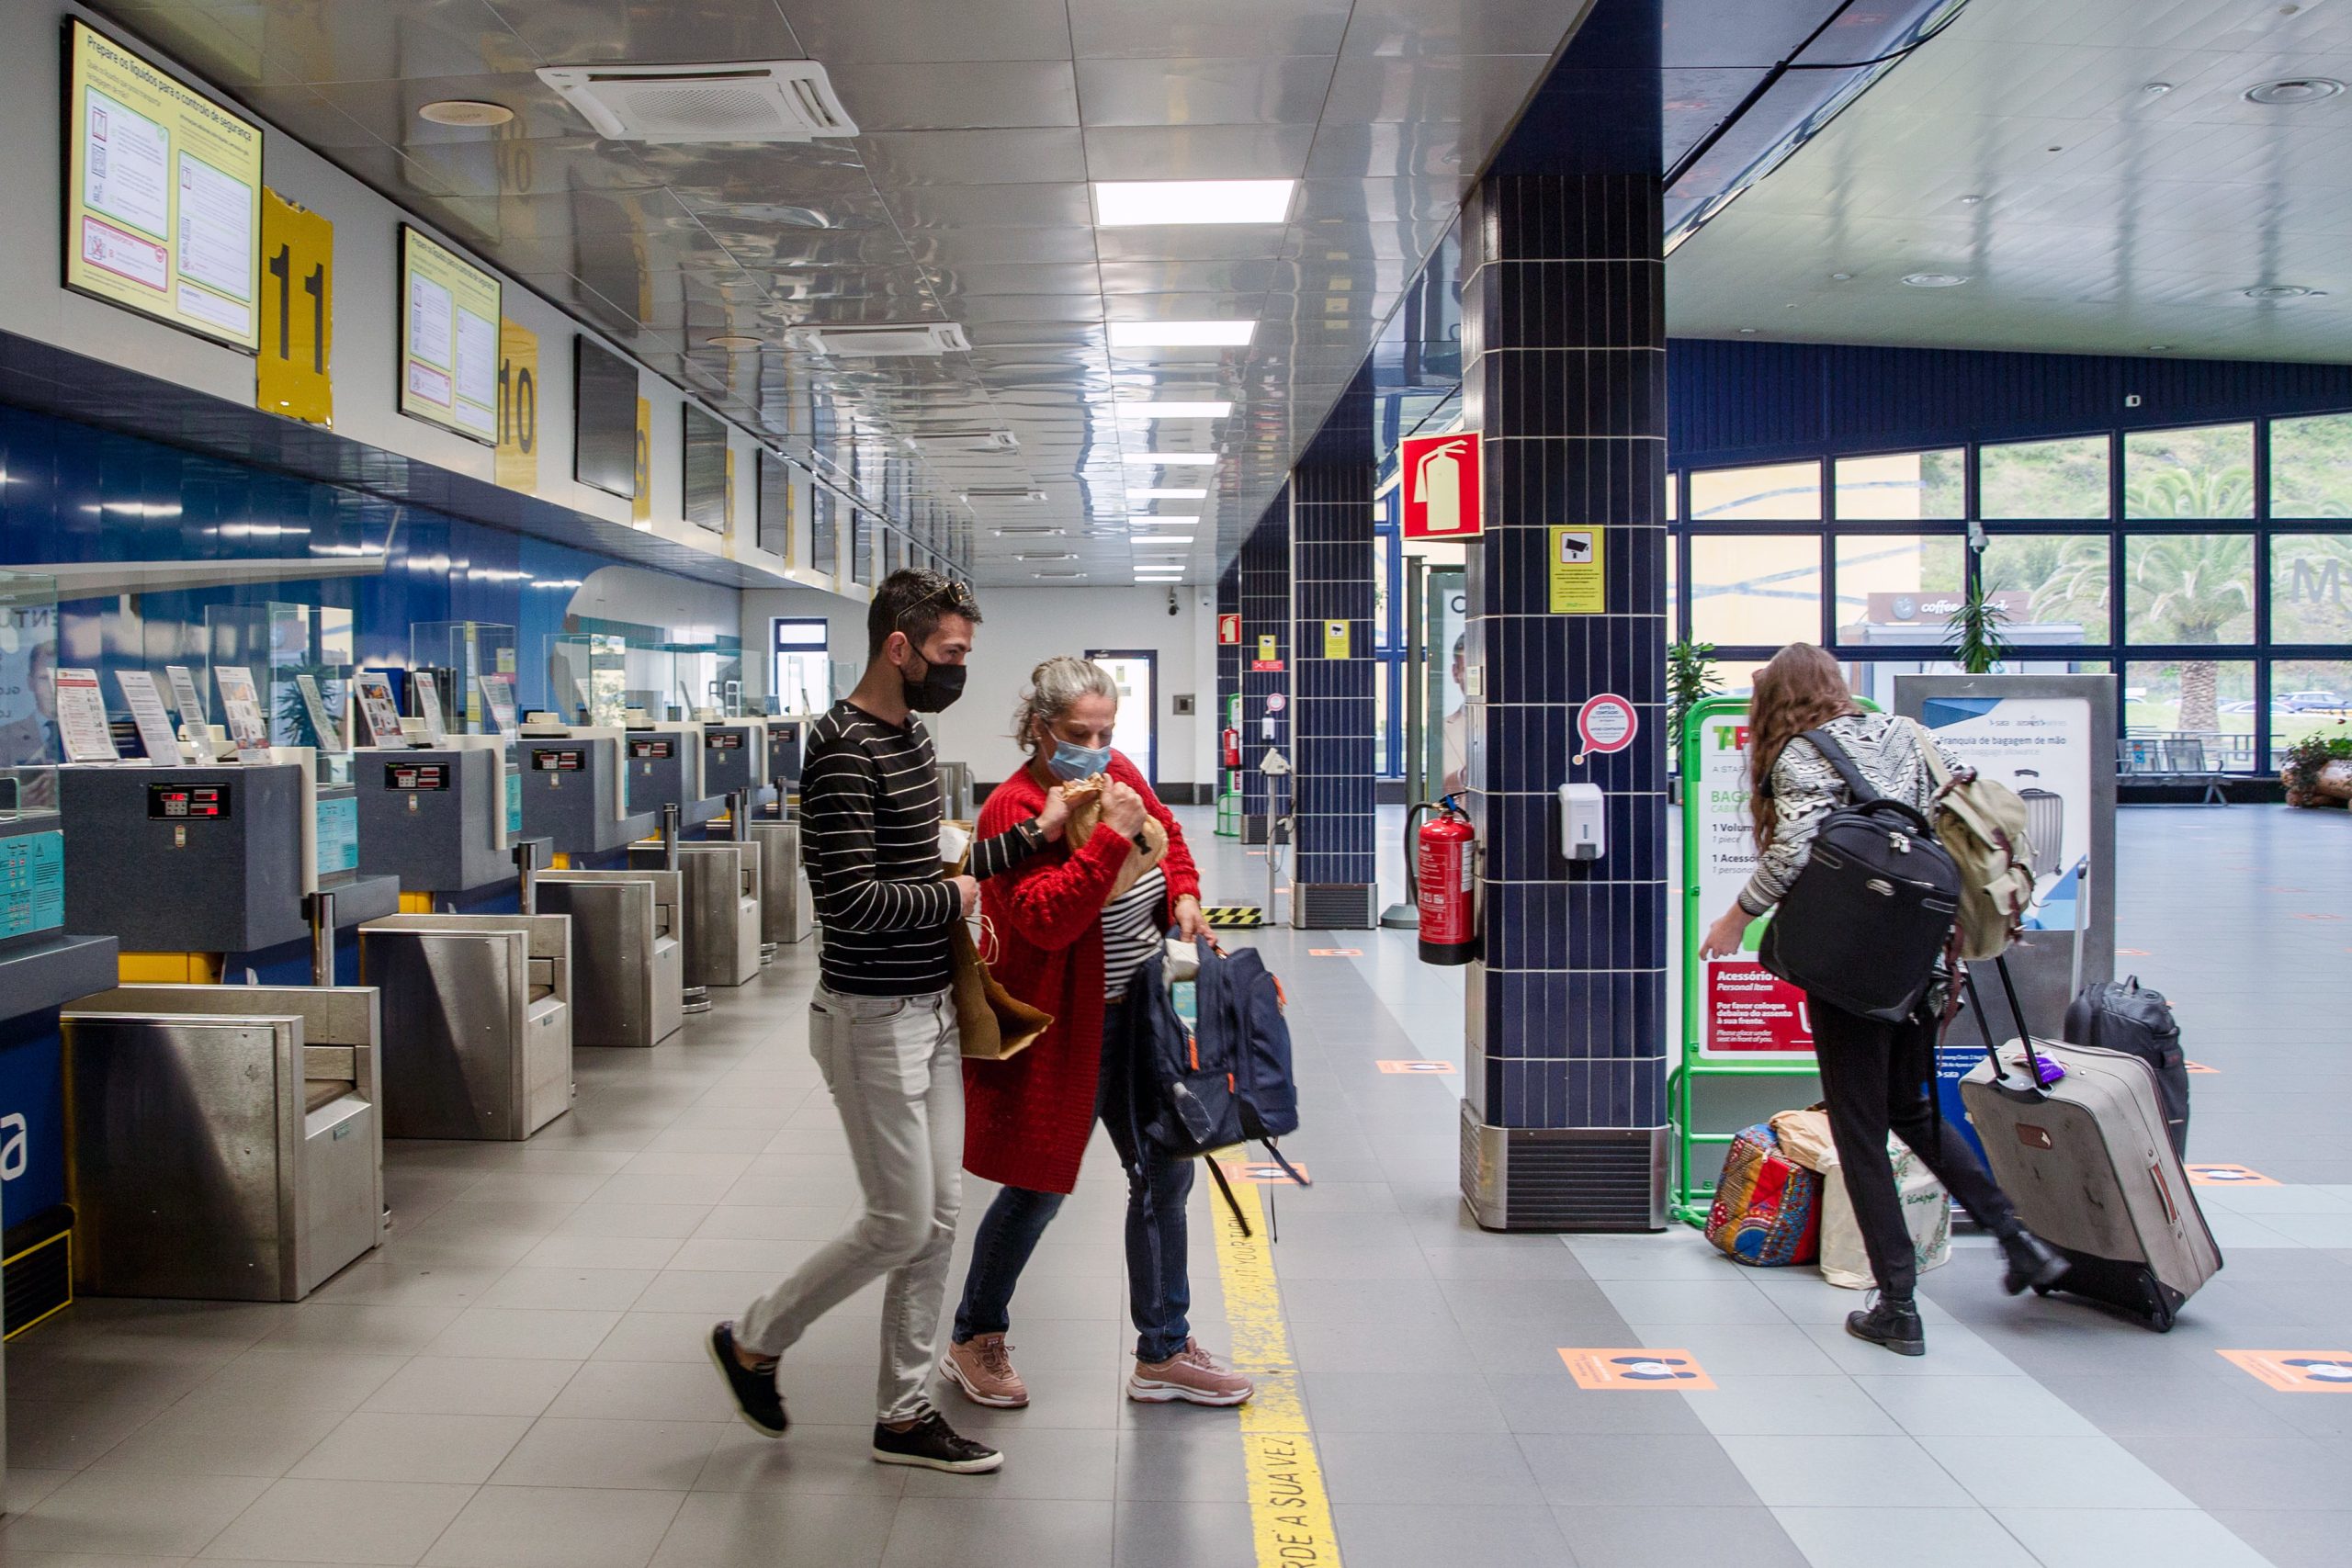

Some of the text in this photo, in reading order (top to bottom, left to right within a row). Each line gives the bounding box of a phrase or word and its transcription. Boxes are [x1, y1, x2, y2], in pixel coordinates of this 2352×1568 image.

[87, 34, 119, 64] Prepare
[119, 57, 129, 70] os
[158, 81, 175, 97] para
[210, 111, 220, 123] de
[269, 243, 324, 375] 11
[500, 358, 534, 454] 10
[1921, 599, 1961, 615] coffee
[1713, 726, 1749, 750] TAP
[1979, 736, 1989, 745] de
[1992, 736, 2032, 746] bagagem
[2035, 736, 2045, 745] de
[2047, 735, 2066, 745] mão
[1712, 790, 1751, 803] BAGA
[1720, 823, 1754, 832] Volum
[1720, 853, 1758, 863] Acessó
[1716, 971, 1773, 981] Acessório
[1230, 1241, 1257, 1265] YOUR
[1261, 1437, 1317, 1568] RDE A SUA VEZ
